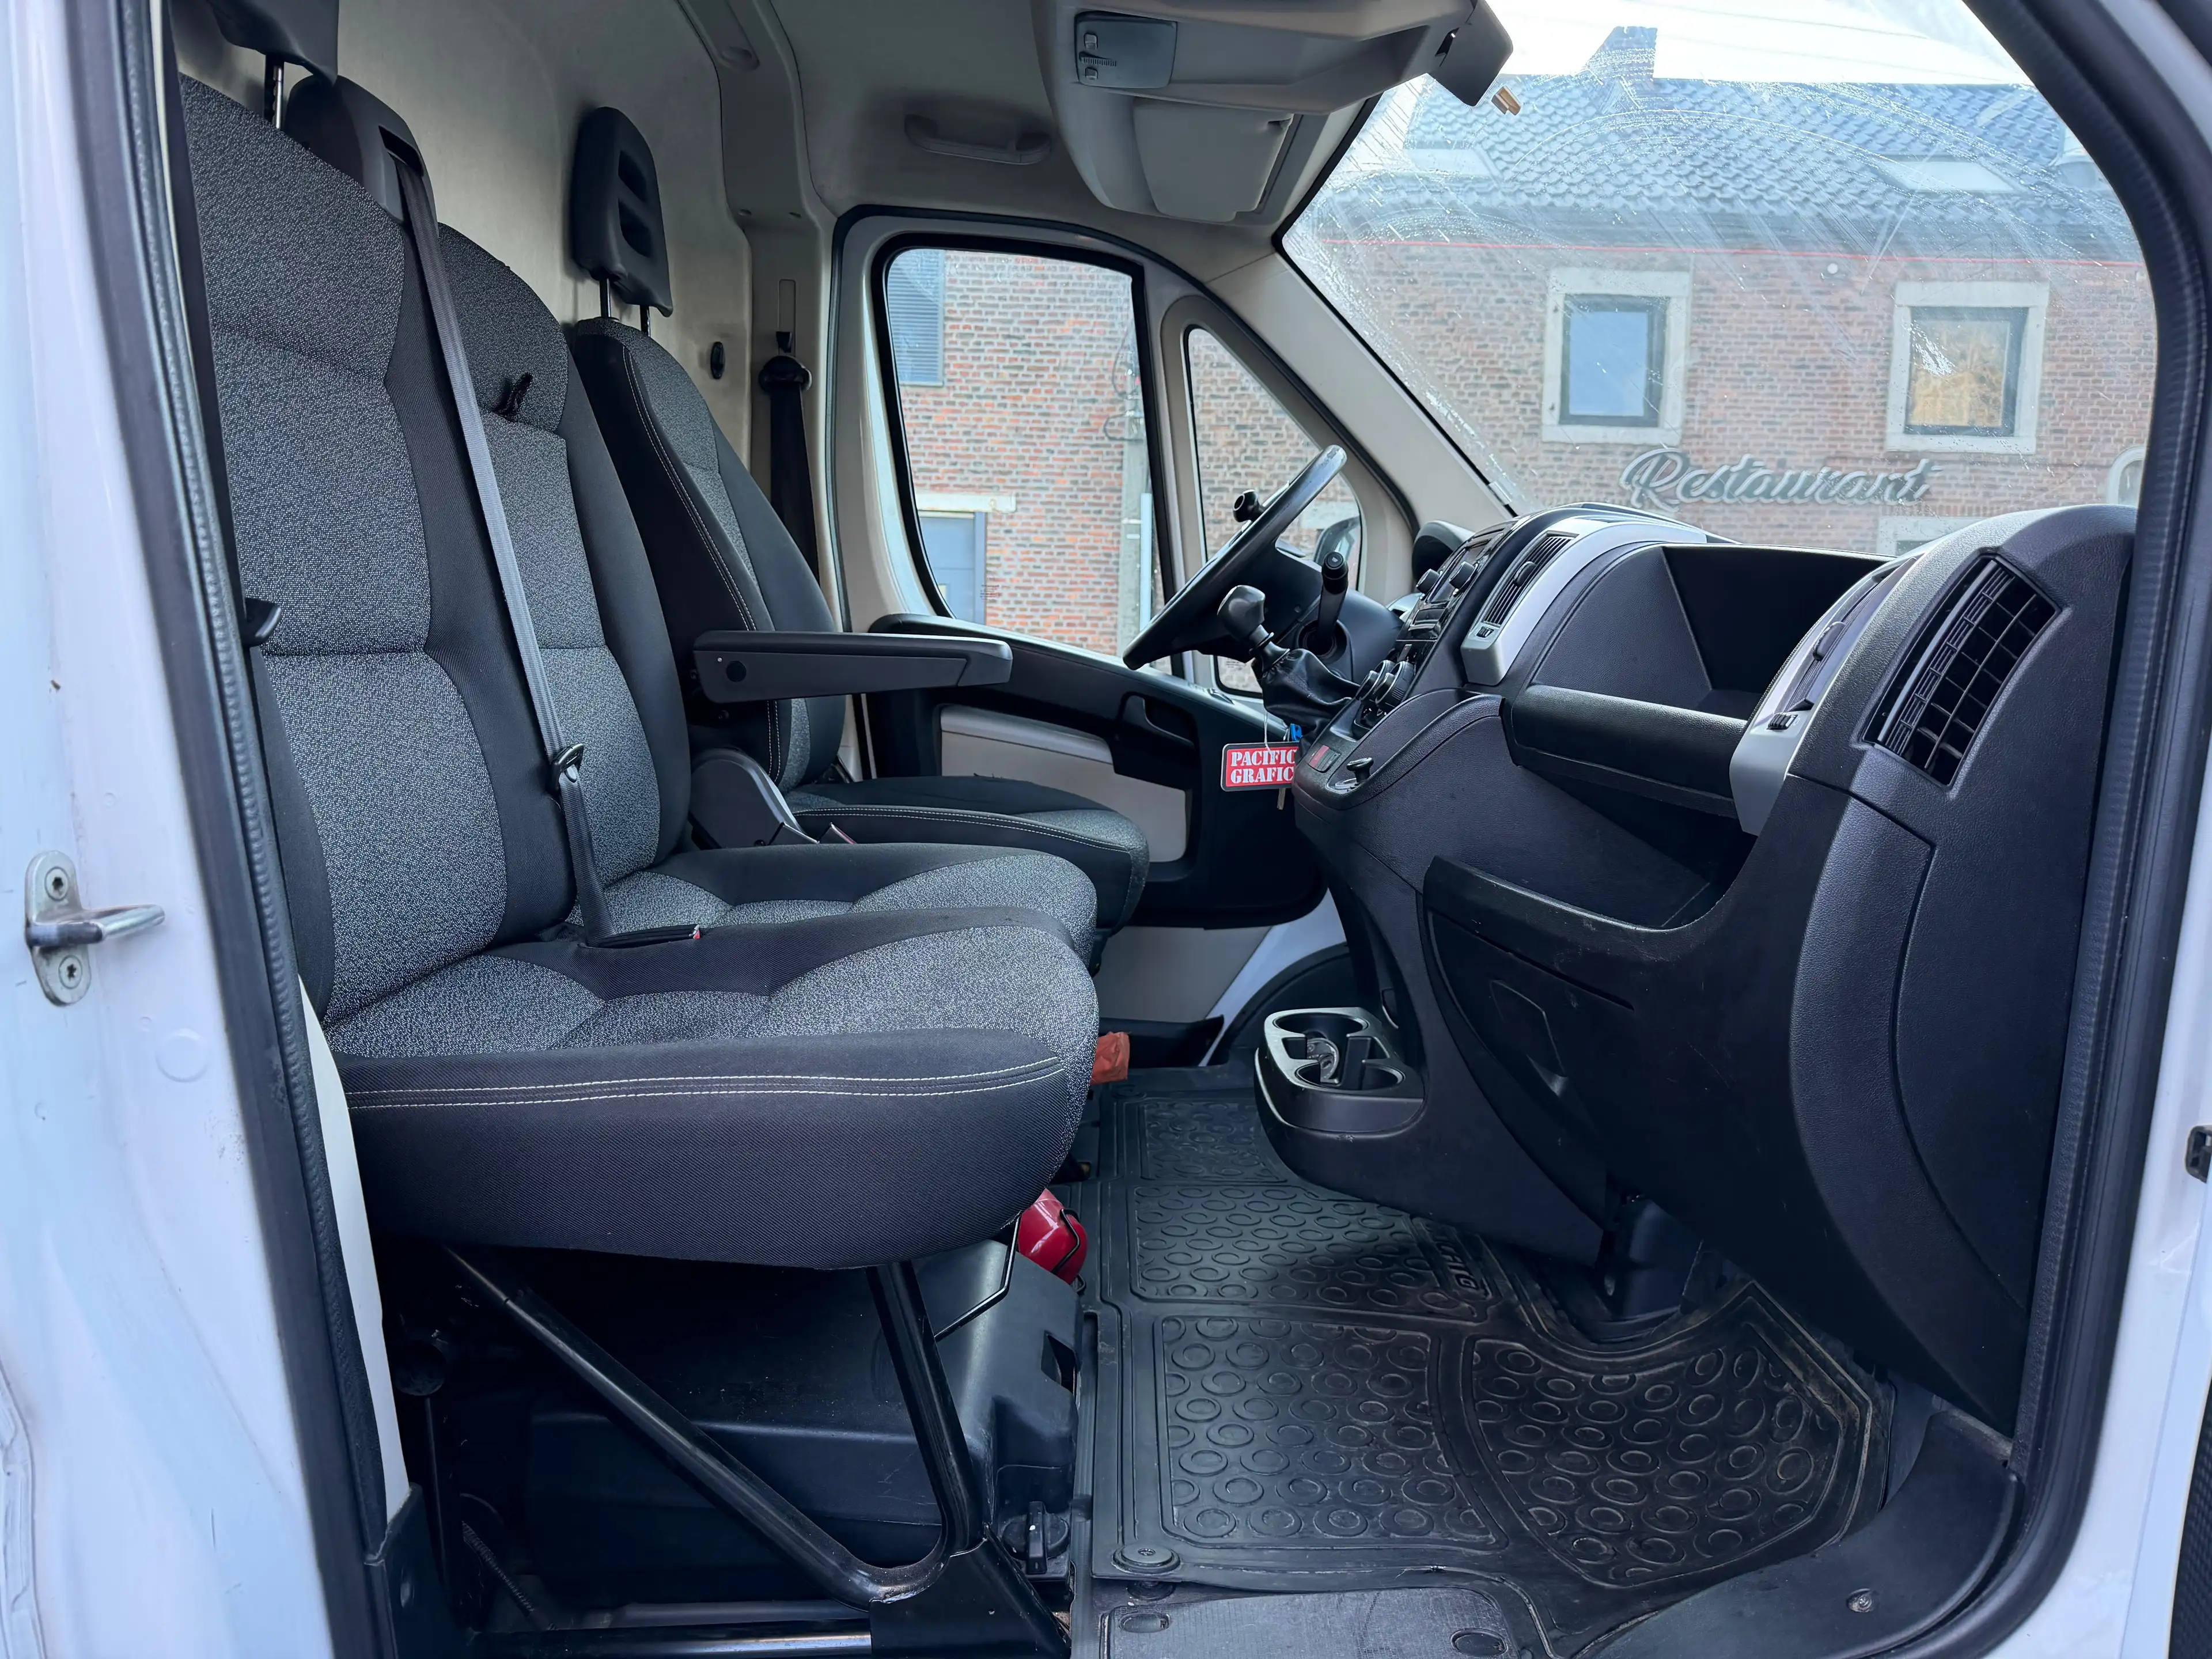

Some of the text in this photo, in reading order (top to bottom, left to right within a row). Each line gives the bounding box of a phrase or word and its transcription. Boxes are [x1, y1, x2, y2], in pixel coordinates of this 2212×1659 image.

[1619, 448, 1944, 513] Restaurant
[1231, 749, 1297, 767] PACIFIC
[1230, 766, 1294, 784] GRAFIC
